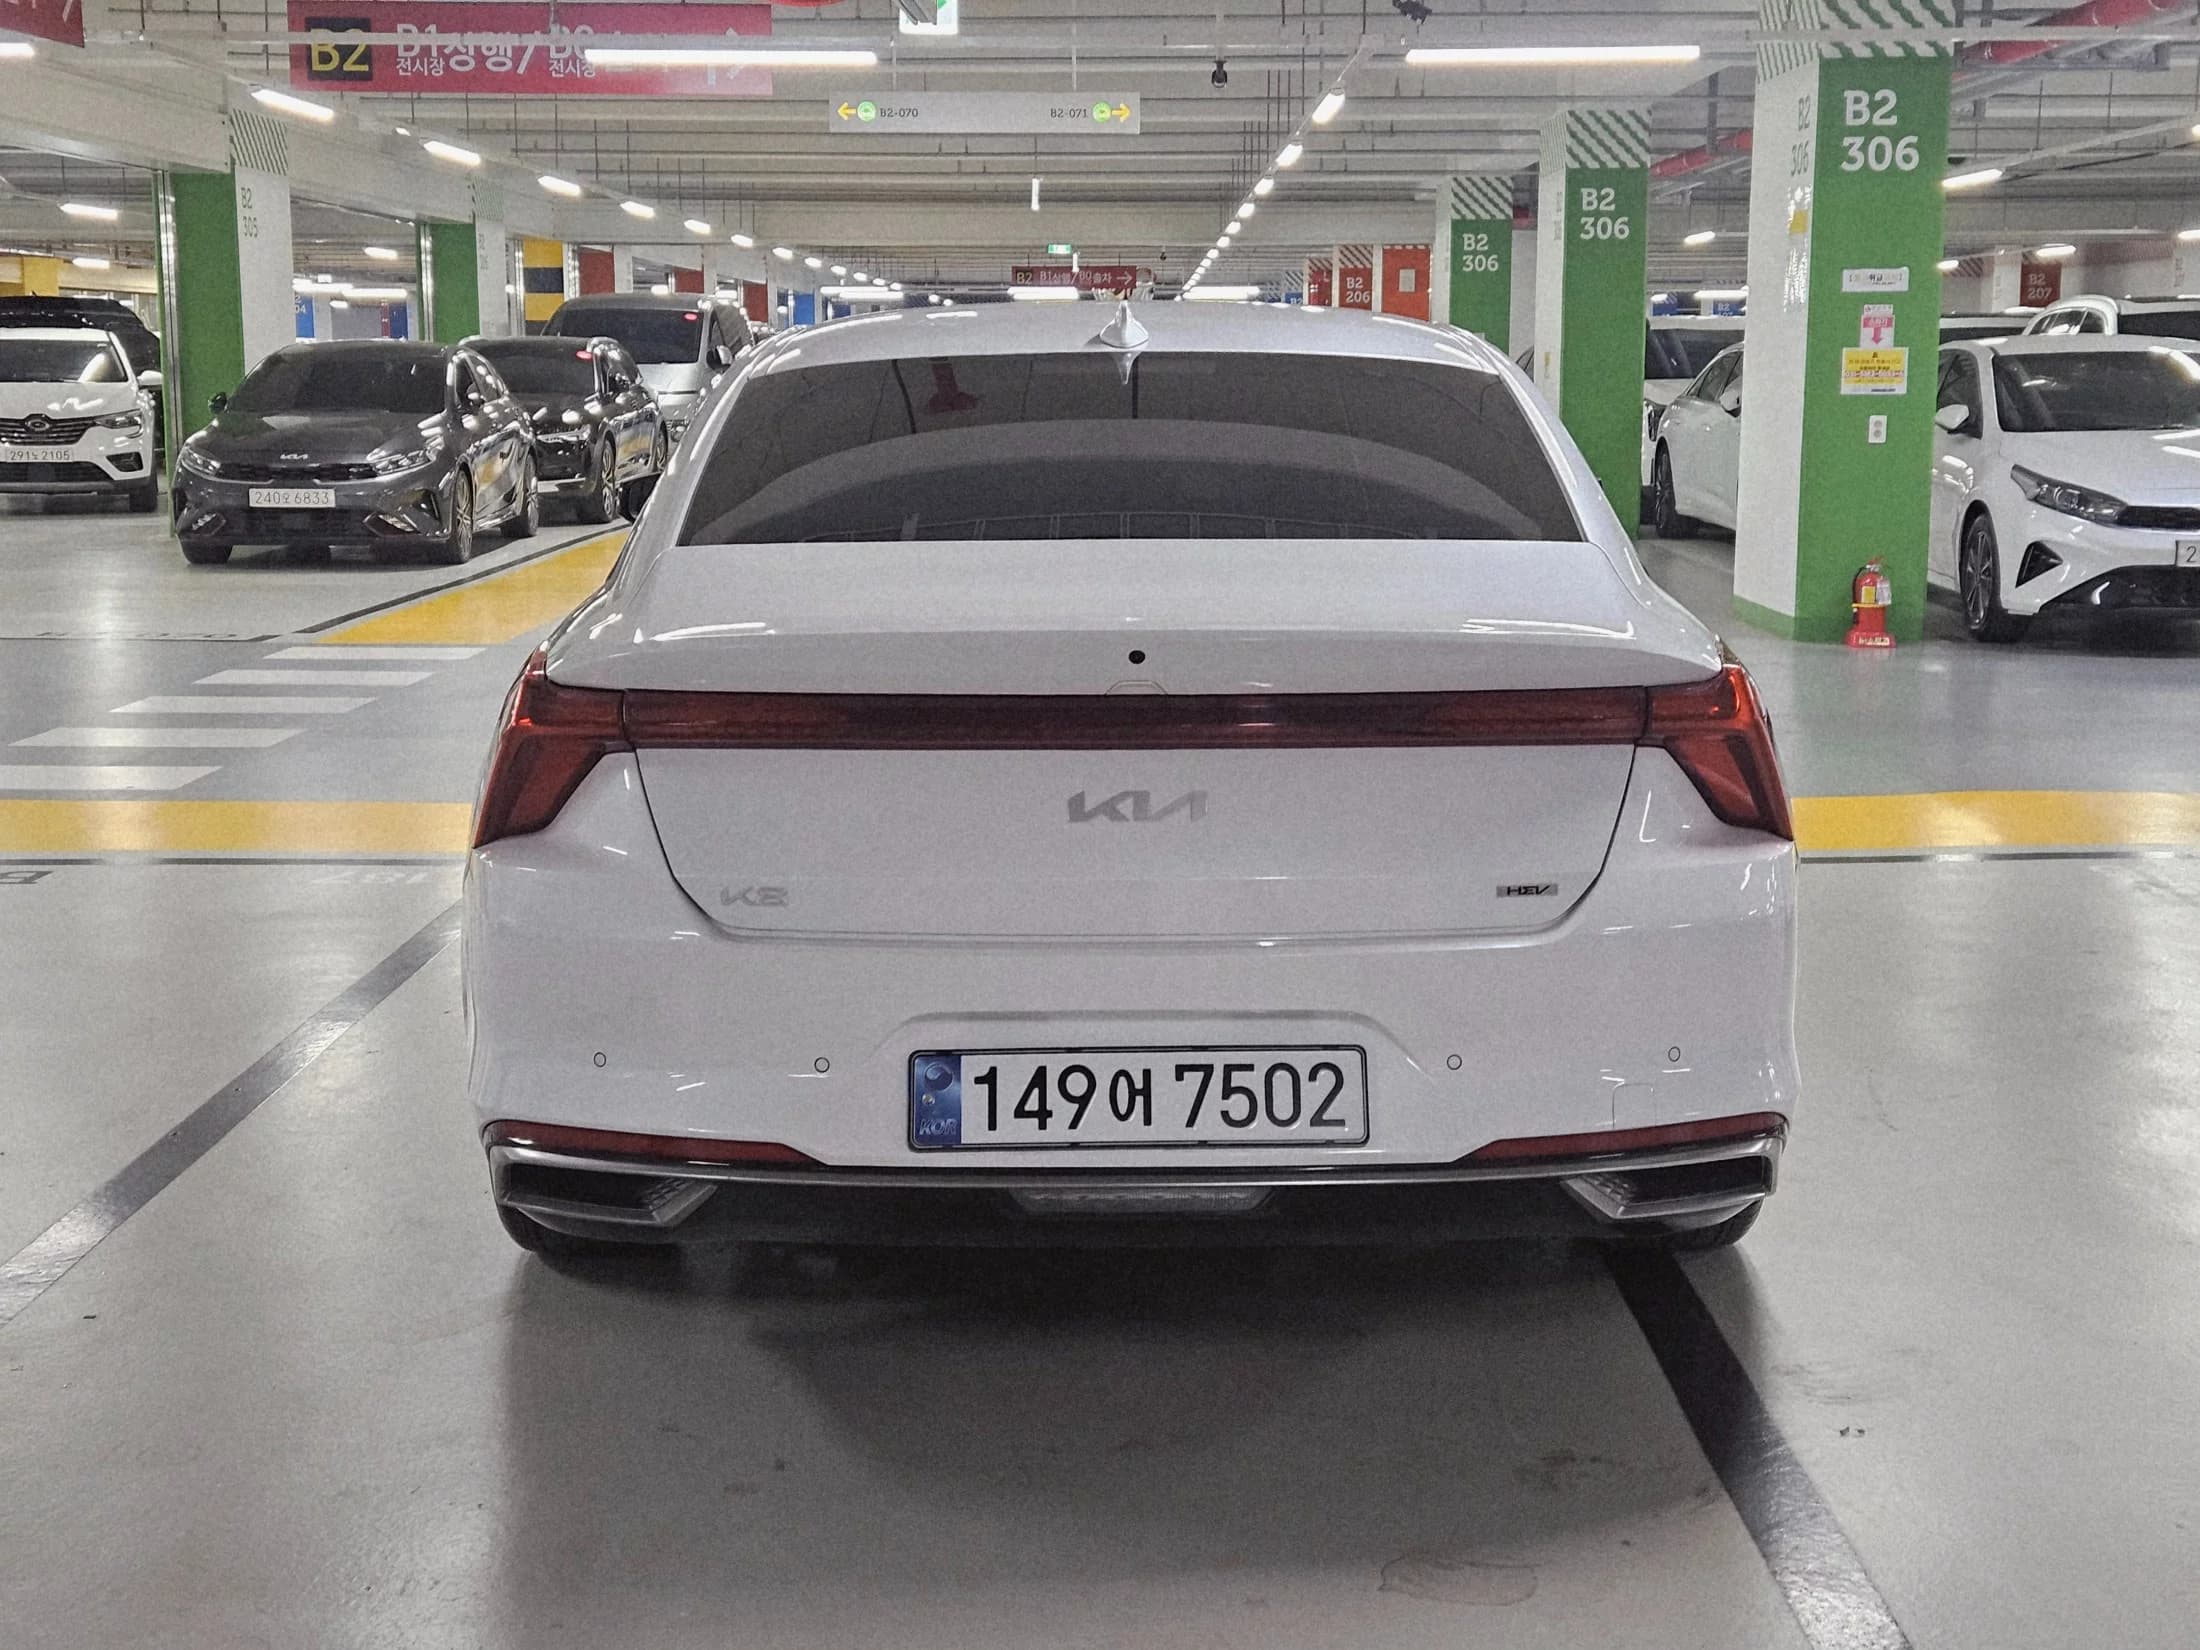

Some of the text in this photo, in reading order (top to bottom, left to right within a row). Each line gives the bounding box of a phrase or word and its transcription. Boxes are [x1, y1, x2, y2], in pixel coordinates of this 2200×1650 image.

[310, 27, 370, 72] B2
[396, 57, 446, 77] 전시장
[879, 107, 919, 118] B2-070
[1050, 108, 1089, 119] B2-071
[1843, 88, 1898, 126] B2
[1840, 135, 1920, 172] 306
[1581, 187, 1616, 211] B2
[1580, 216, 1630, 240] 306
[1462, 233, 1489, 251] B2
[1462, 254, 1499, 272] 306
[1016, 271, 1033, 285] B2
[1346, 276, 1364, 289] B2
[2028, 272, 2047, 285] B2
[1345, 290, 1371, 304] 206
[2026, 286, 2052, 300] 207
[41, 450, 70, 461] 2105
[294, 491, 329, 505] 6833
[720, 886, 788, 906] K8
[1507, 884, 1551, 896] HEV
[973, 1062, 1346, 1131] 149어 7502
[919, 1118, 958, 1136] KOR
